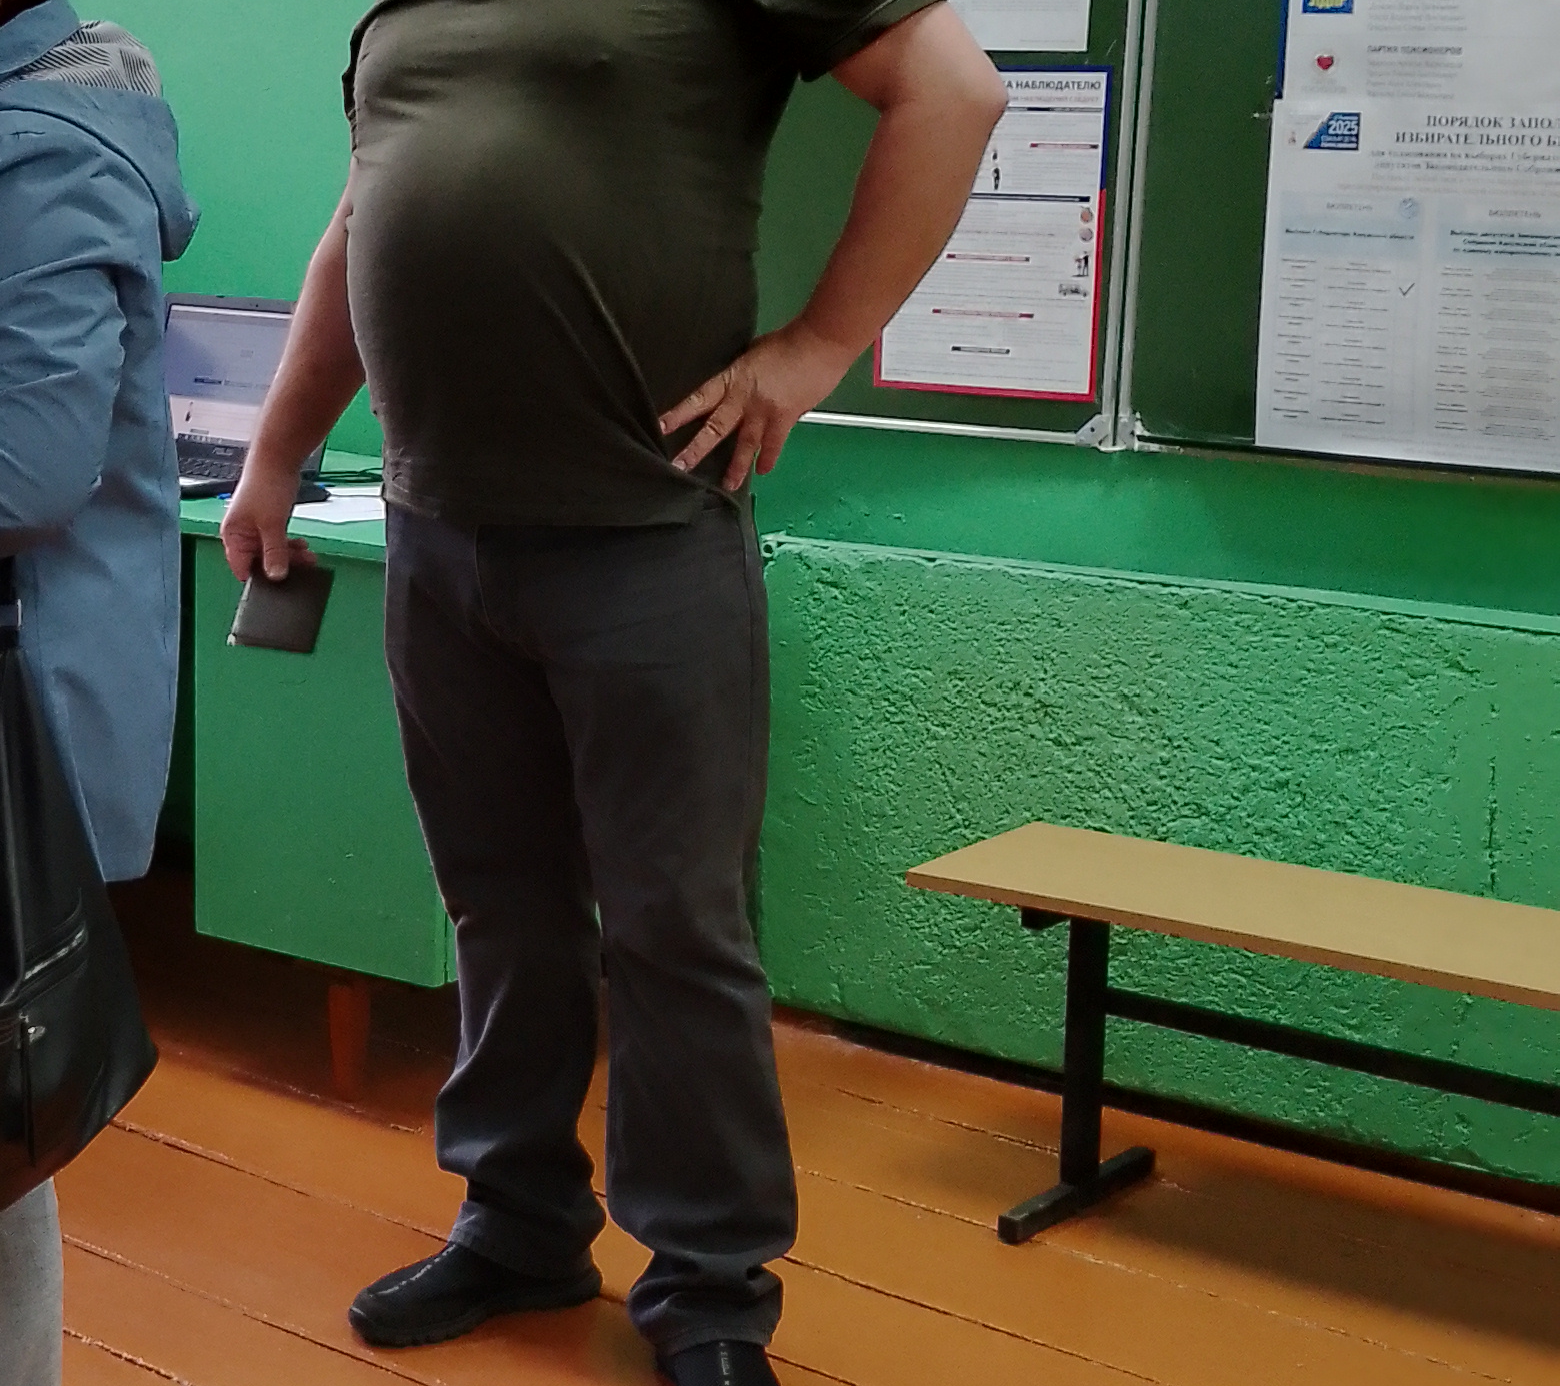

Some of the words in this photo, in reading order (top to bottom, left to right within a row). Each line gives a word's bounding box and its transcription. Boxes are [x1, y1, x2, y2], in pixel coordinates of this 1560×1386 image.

[1016, 80, 1101, 91] НАБЛЮДАТЕЛЮ
[1327, 120, 1359, 136] 2025
[1426, 114, 1504, 129] ПОРЯДОК
[1395, 131, 1542, 147] ИЗБИРАТЕЛЬНОГО
